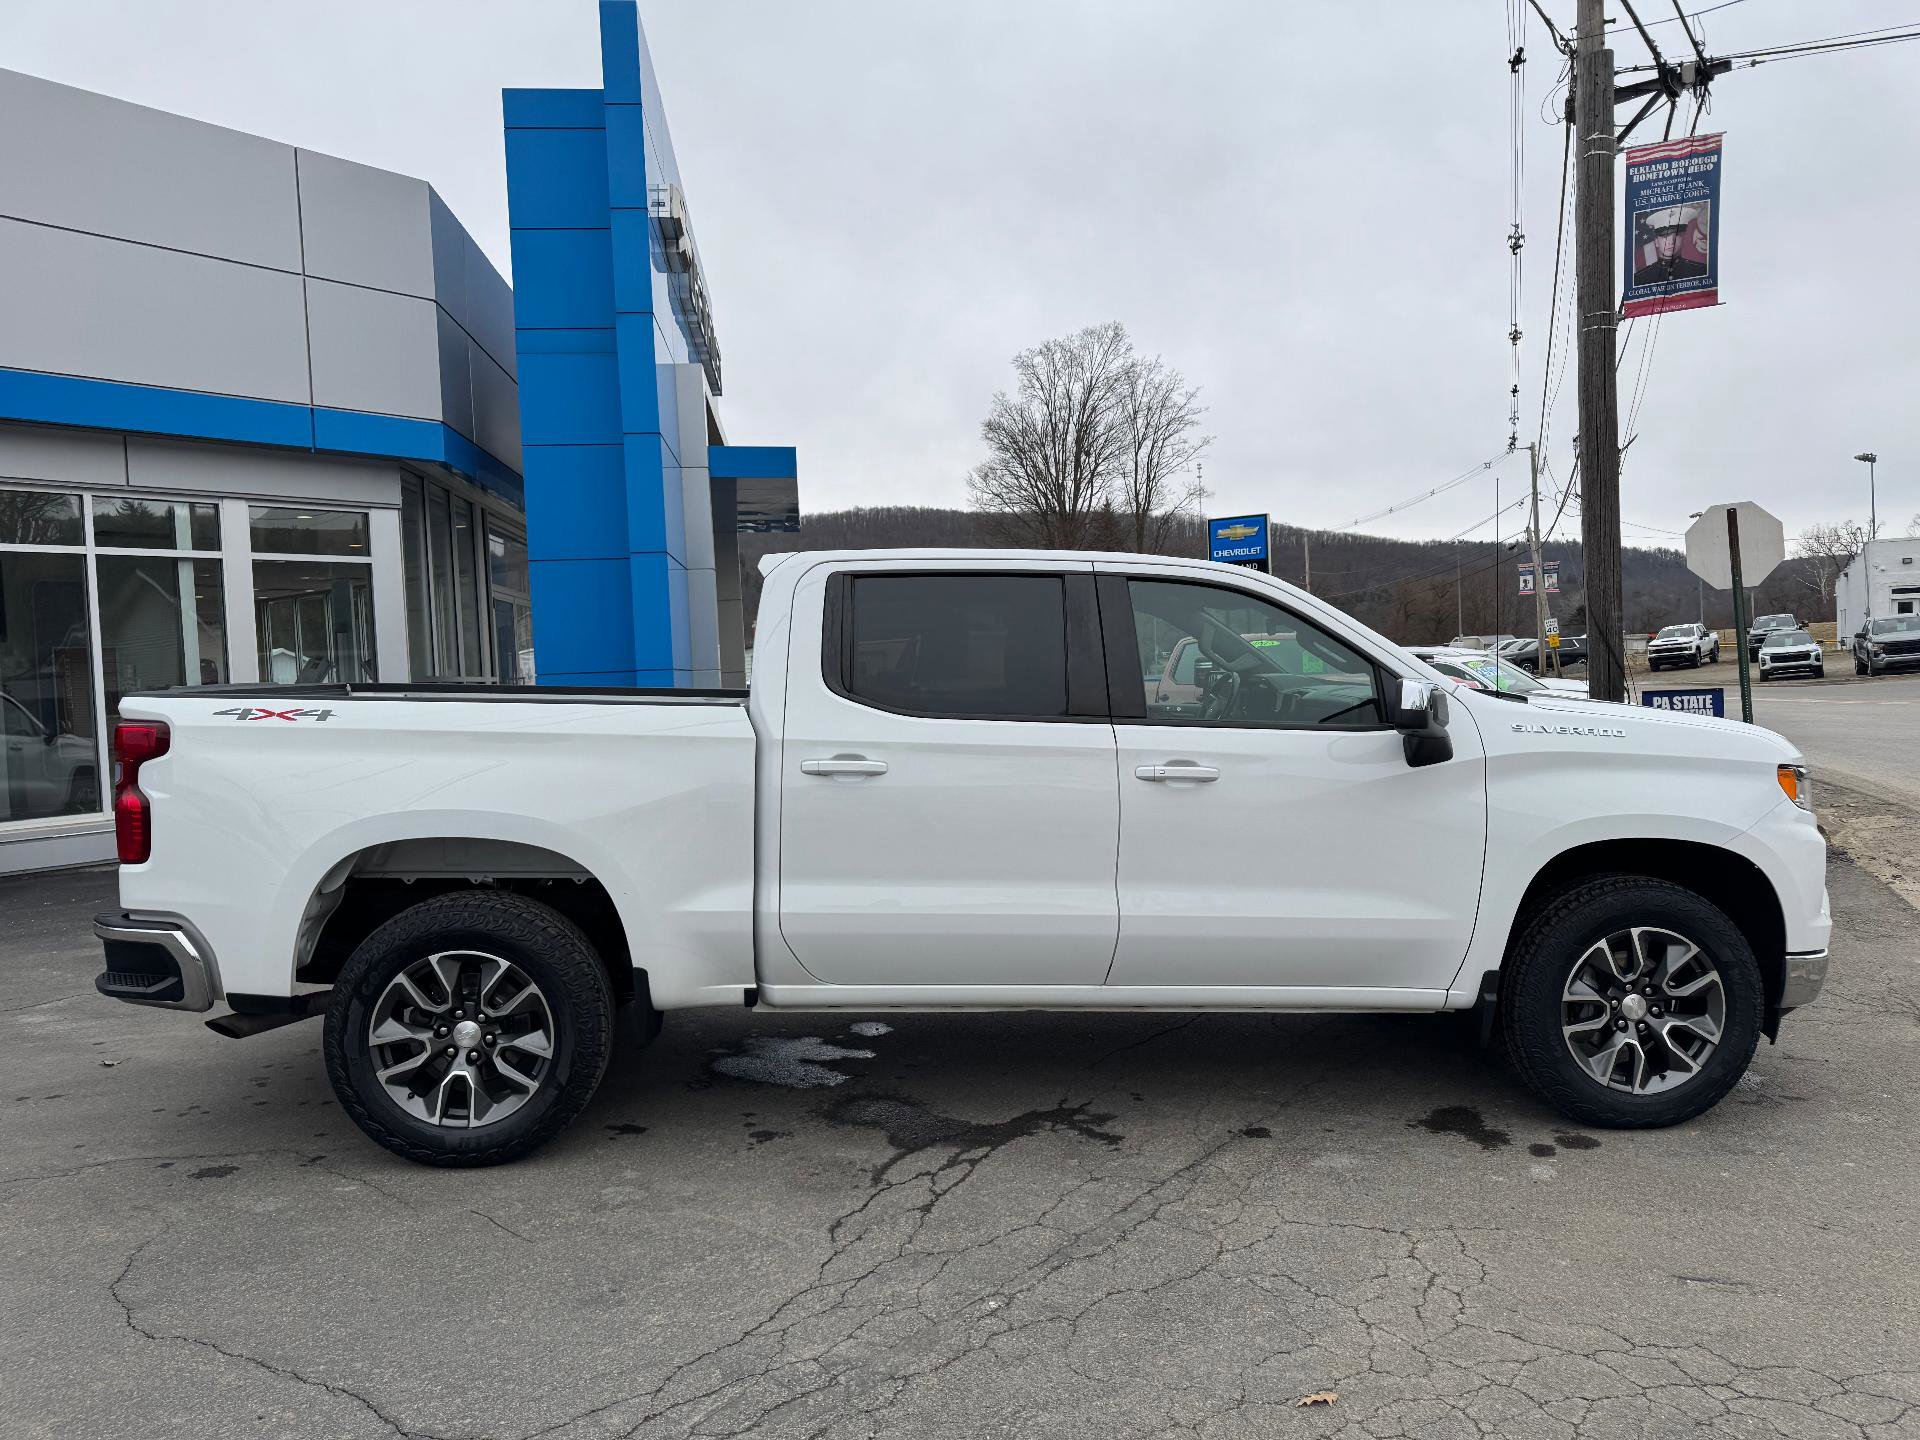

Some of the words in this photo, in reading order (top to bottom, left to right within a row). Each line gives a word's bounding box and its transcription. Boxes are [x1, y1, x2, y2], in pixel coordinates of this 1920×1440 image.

[1630, 162, 1669, 176] ELKLAND
[1672, 155, 1718, 169] BOROUGH
[1633, 166, 1685, 183] HOMETOWN
[1688, 163, 1714, 174] HERO
[1677, 180, 1705, 191] PLANK
[1650, 192, 1681, 204] MARINE
[1684, 189, 1710, 199] CORPS
[1213, 546, 1262, 558] CHEVROLET
[1652, 696, 1671, 710] PA
[1672, 694, 1713, 710] STATE
[1510, 723, 1627, 738] SILVERADO
